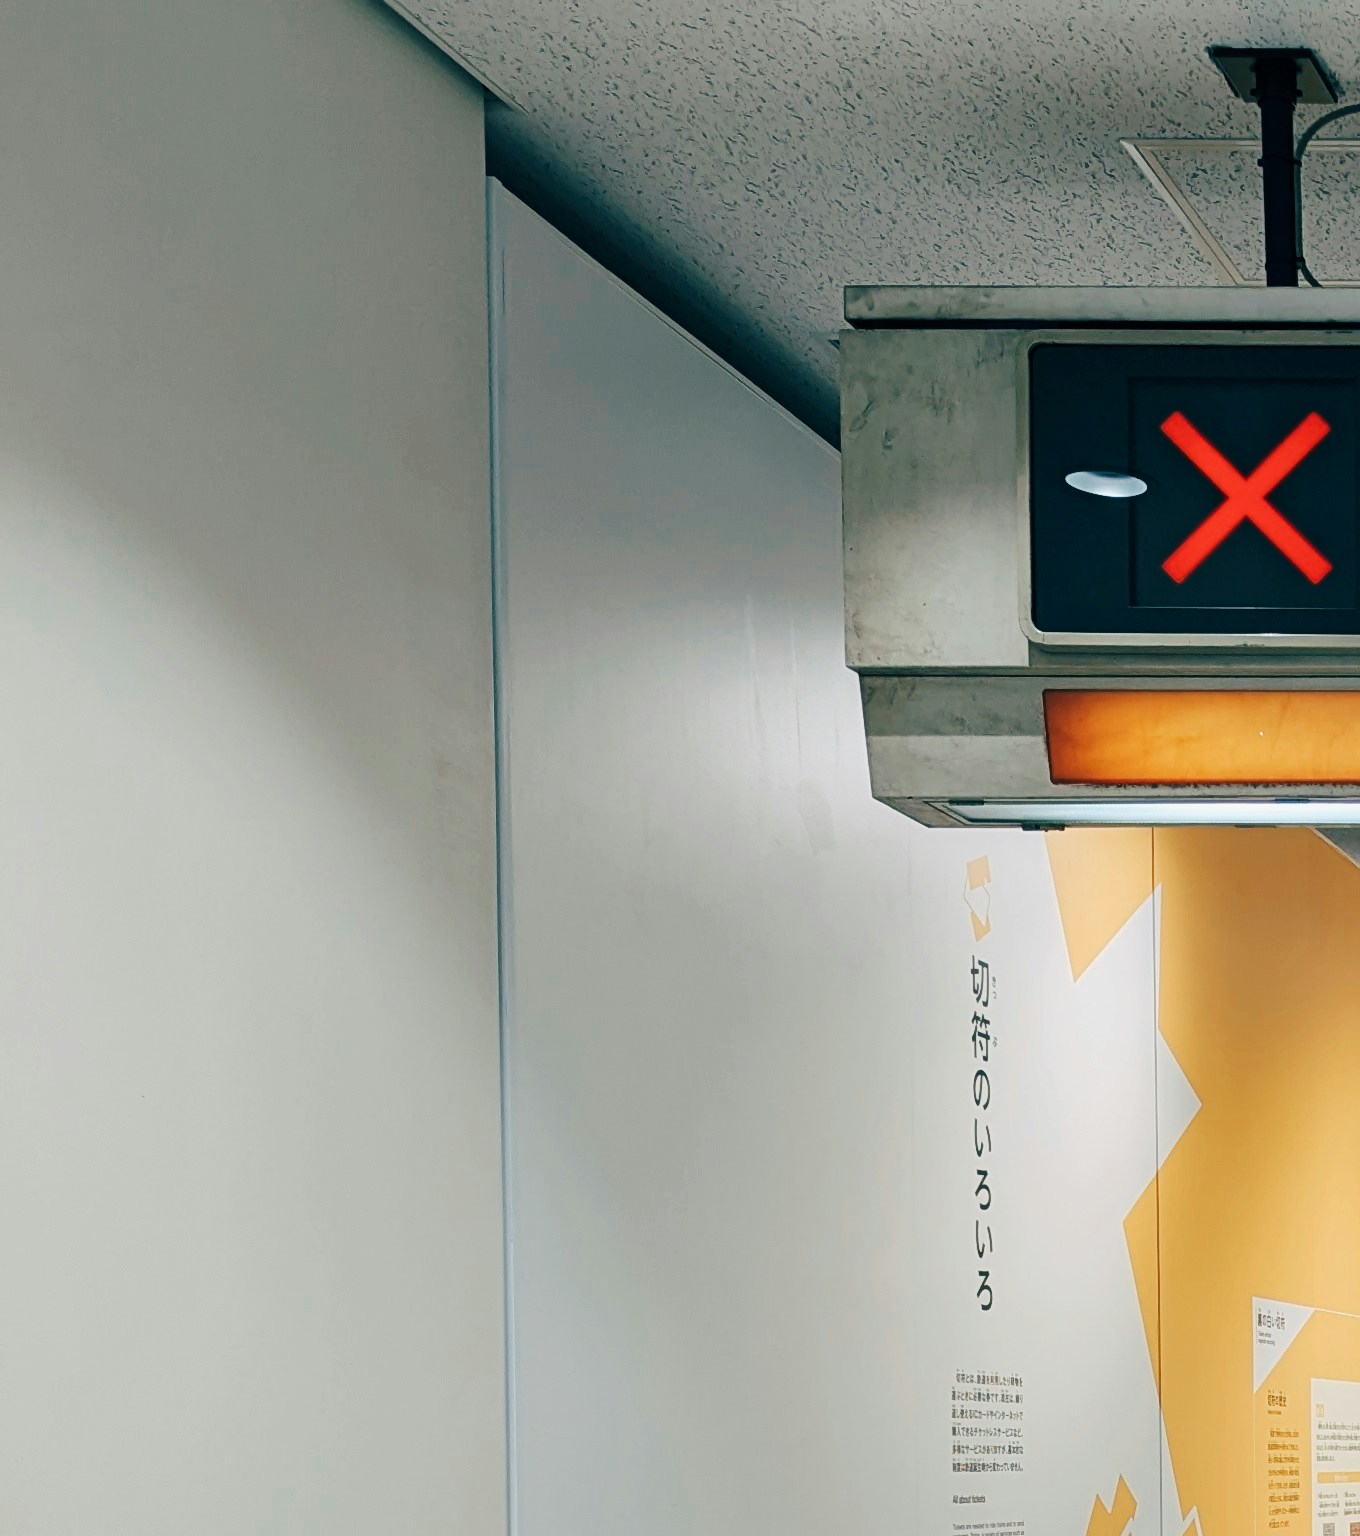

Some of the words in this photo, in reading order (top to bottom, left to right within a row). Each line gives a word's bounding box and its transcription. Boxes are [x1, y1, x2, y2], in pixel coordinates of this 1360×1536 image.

[971, 955, 993, 1311] 切符のいろいろ
